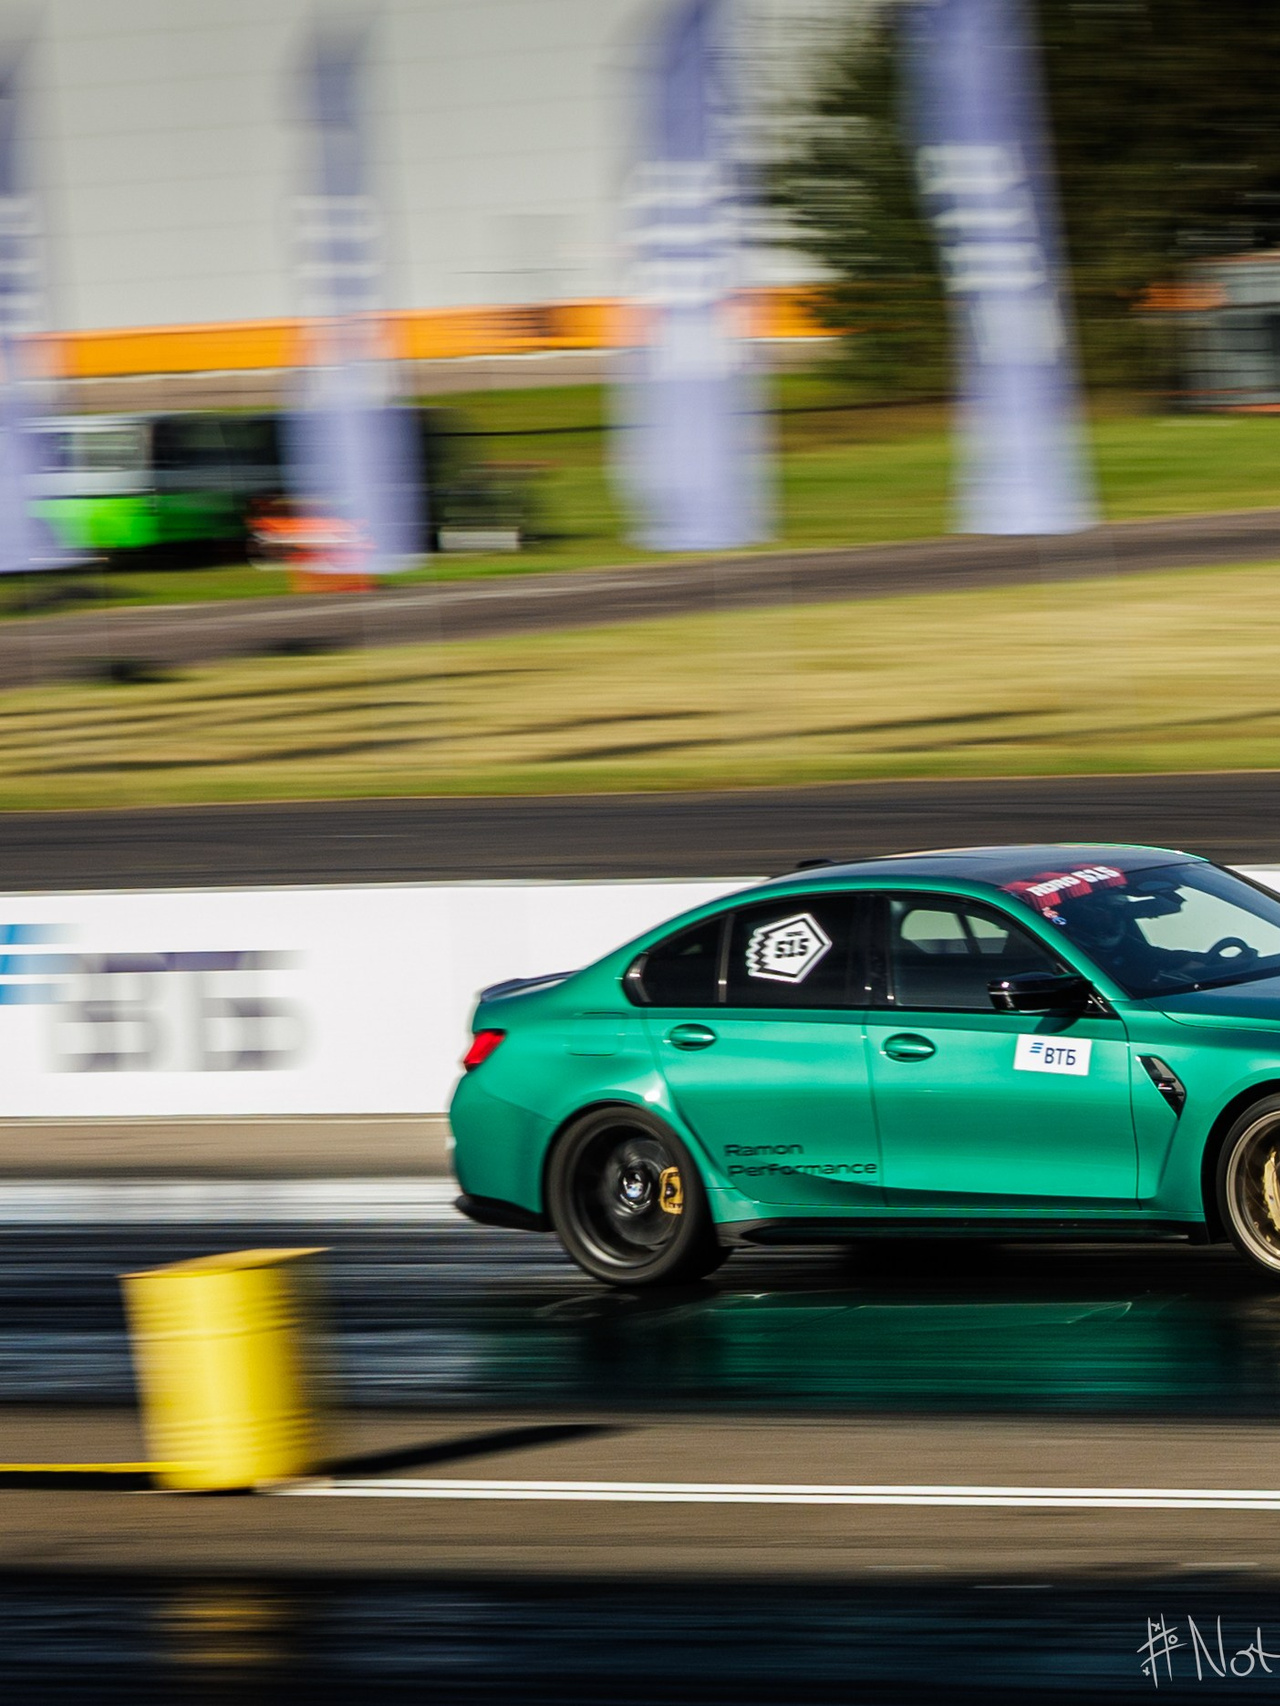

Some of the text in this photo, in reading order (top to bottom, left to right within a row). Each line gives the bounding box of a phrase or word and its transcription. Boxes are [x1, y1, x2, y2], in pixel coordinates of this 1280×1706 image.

[1044, 1047, 1077, 1066] ВТБ
[725, 1144, 803, 1156] Ramon
[728, 1163, 877, 1176] Performance
